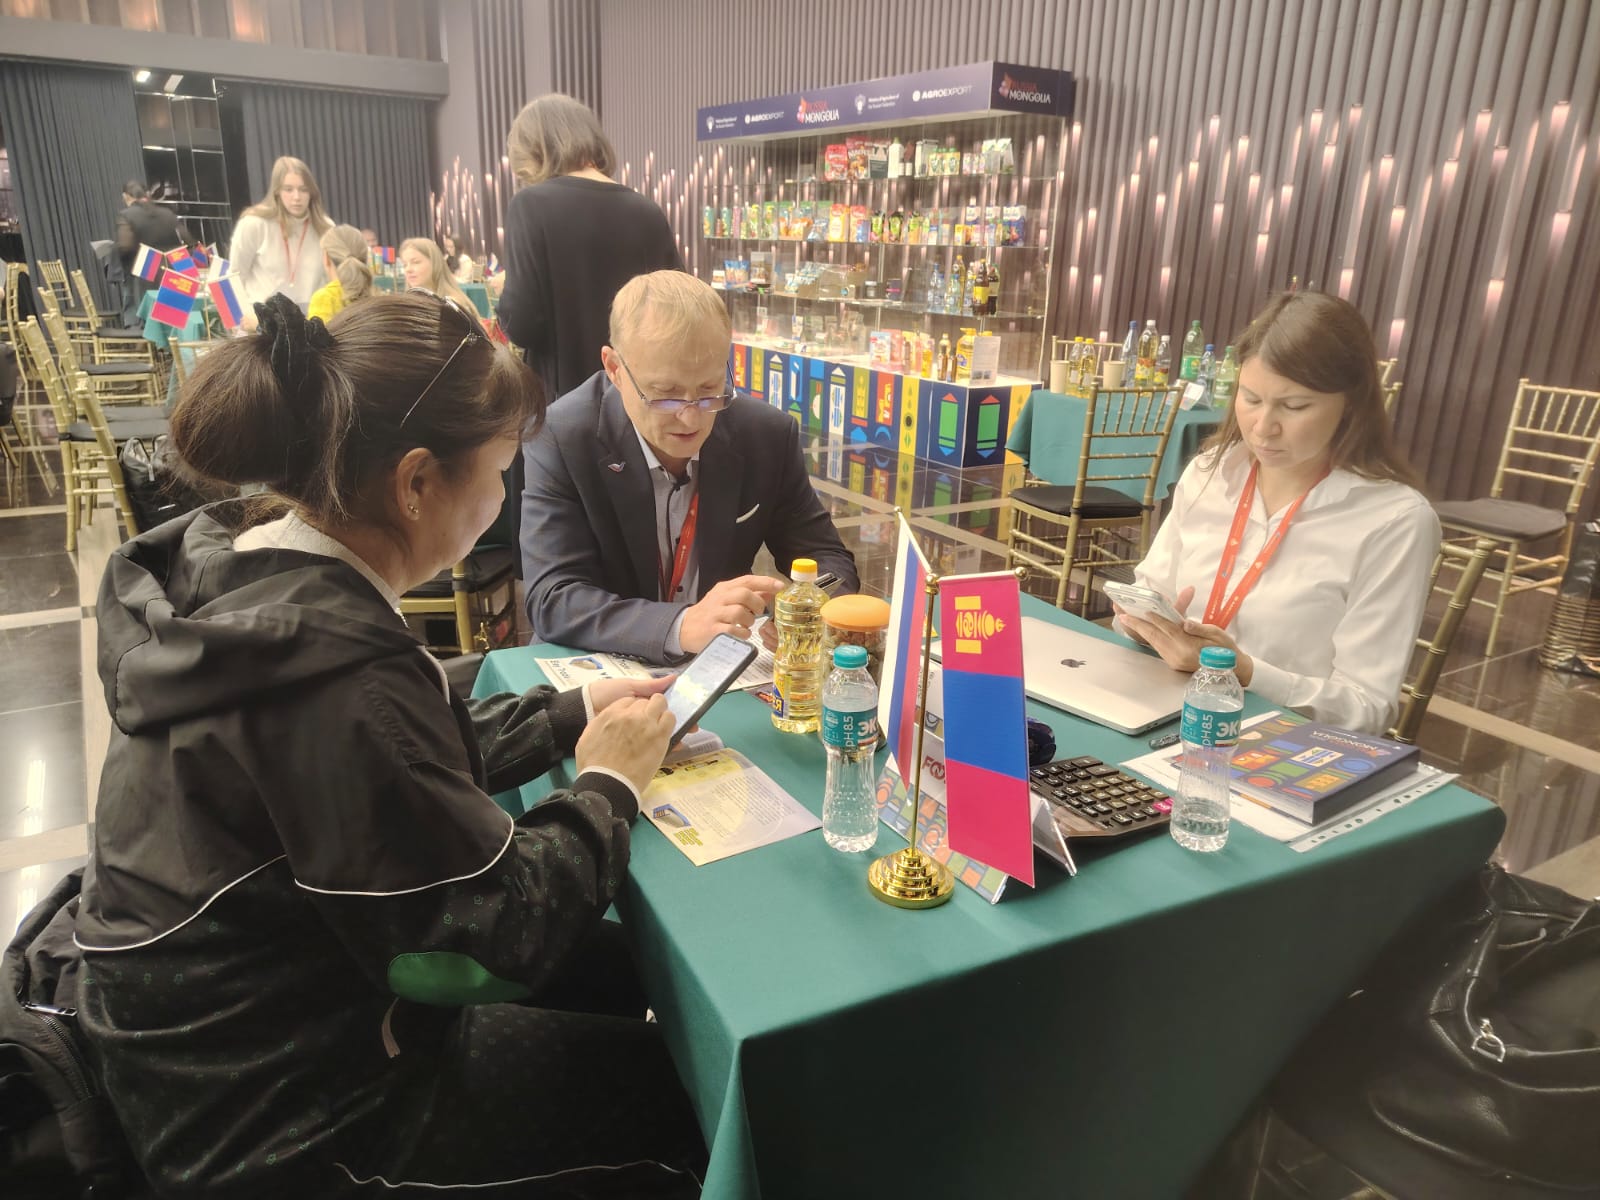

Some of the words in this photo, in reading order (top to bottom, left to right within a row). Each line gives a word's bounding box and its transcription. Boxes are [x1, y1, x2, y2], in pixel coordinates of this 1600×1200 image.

[922, 85, 973, 100] AGROEXPORT
[1009, 89, 1051, 104] MONGOLIA
[805, 109, 840, 124] MONGOLIA
[858, 717, 878, 737] ЭК
[1216, 720, 1239, 738] ЭК
